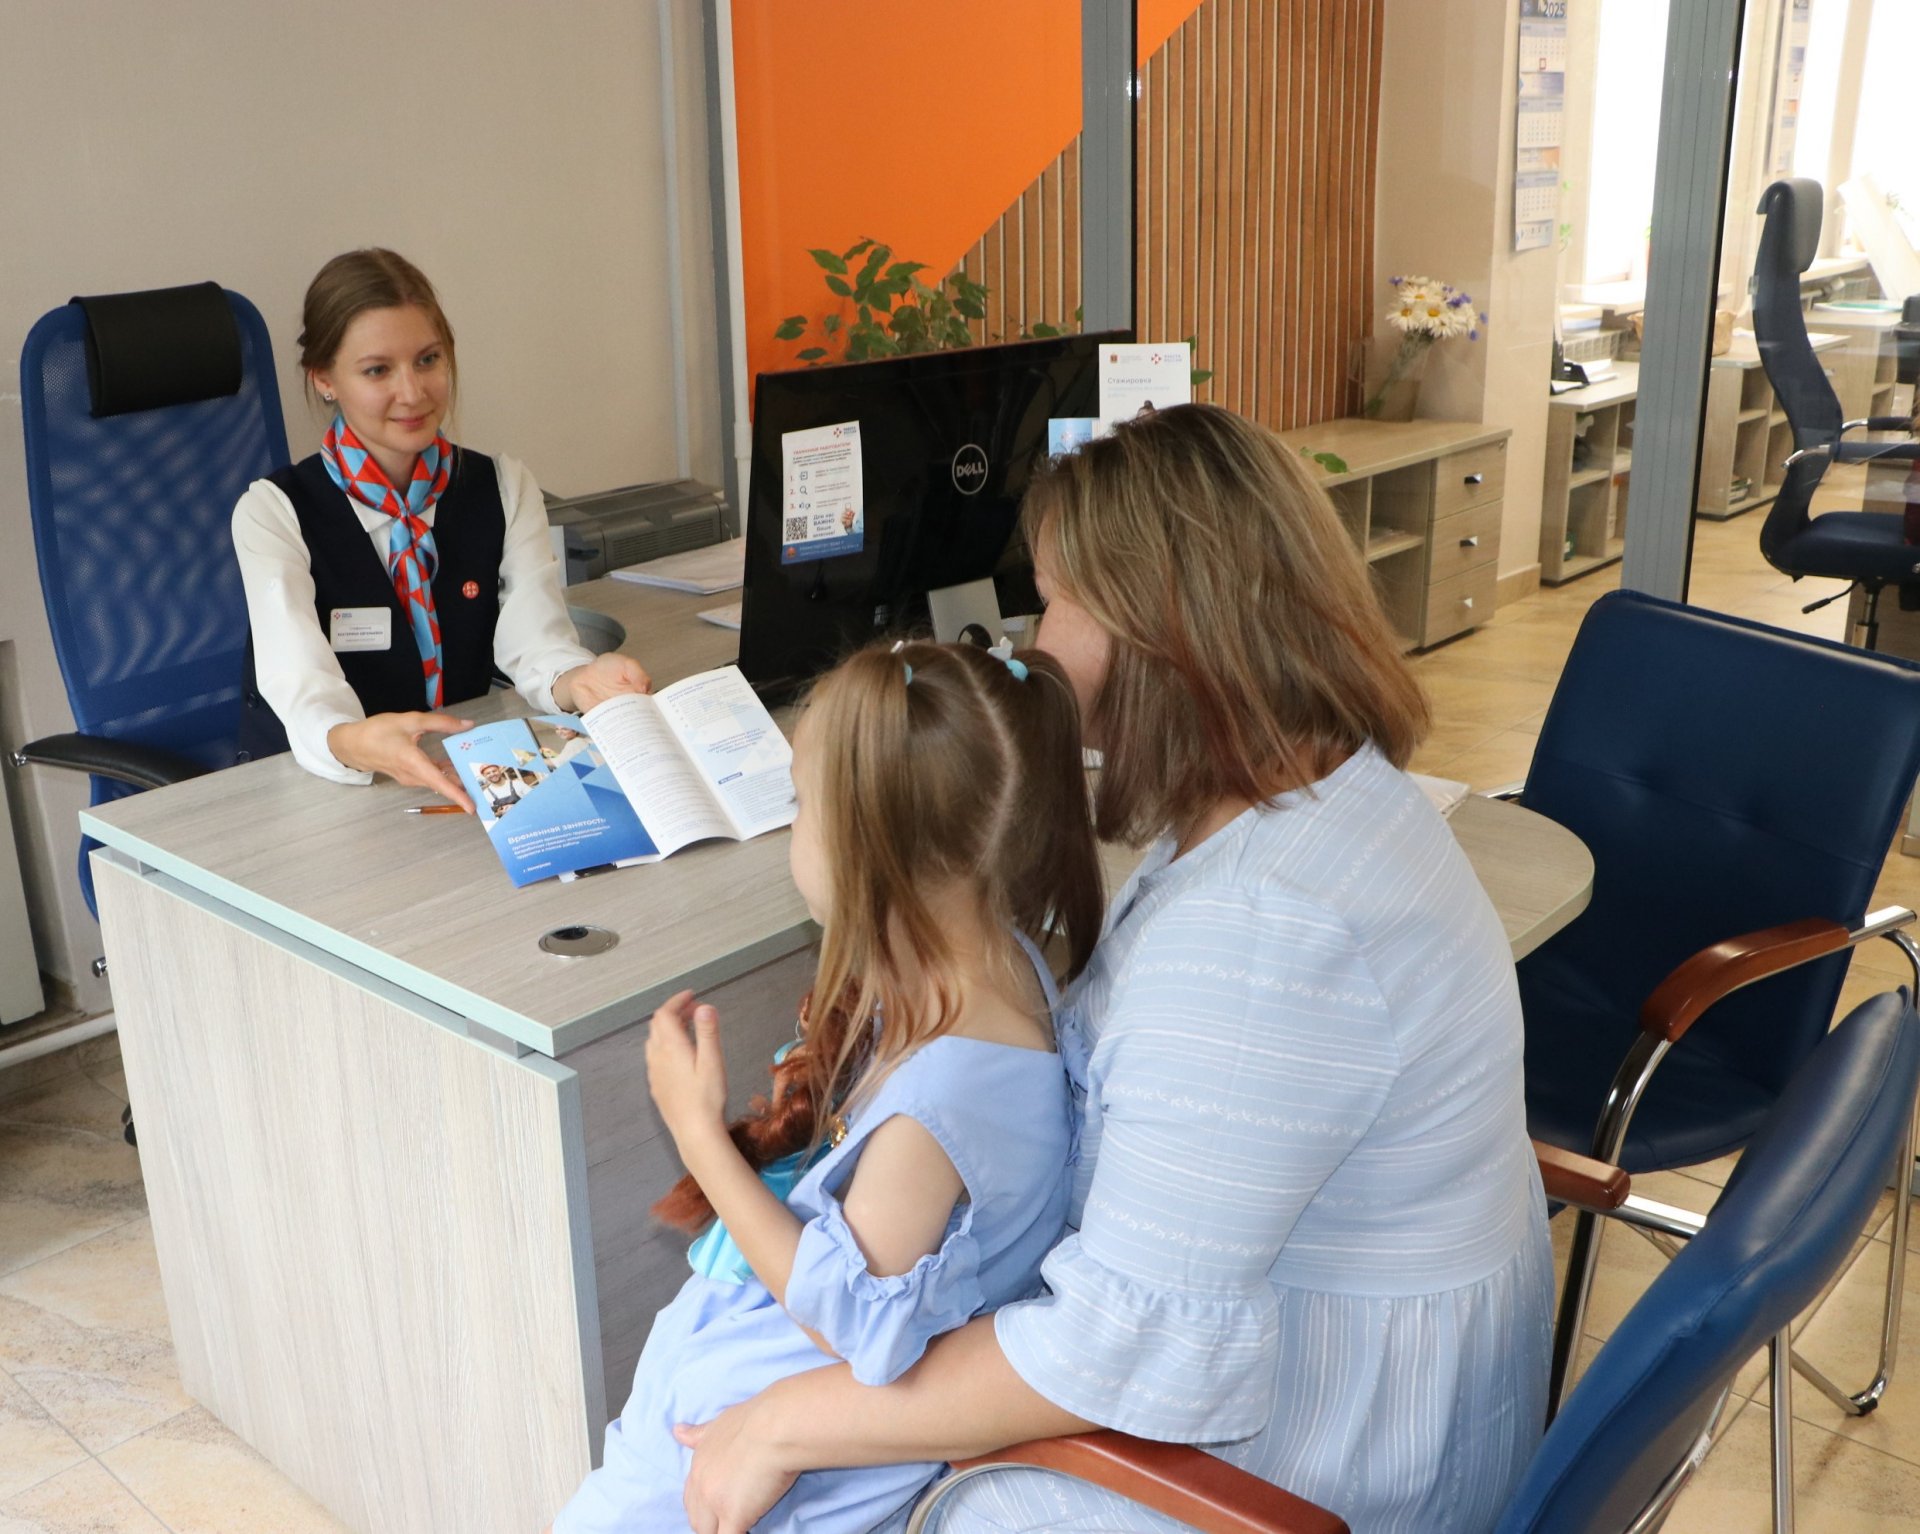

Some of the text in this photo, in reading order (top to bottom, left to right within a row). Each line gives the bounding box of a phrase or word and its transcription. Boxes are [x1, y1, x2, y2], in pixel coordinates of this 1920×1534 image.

[1542, 1, 1566, 18] 2025
[1107, 377, 1152, 385] Стажировка
[956, 461, 984, 478] DELL
[507, 826, 561, 845] Временная
[562, 817, 607, 831] занятость
